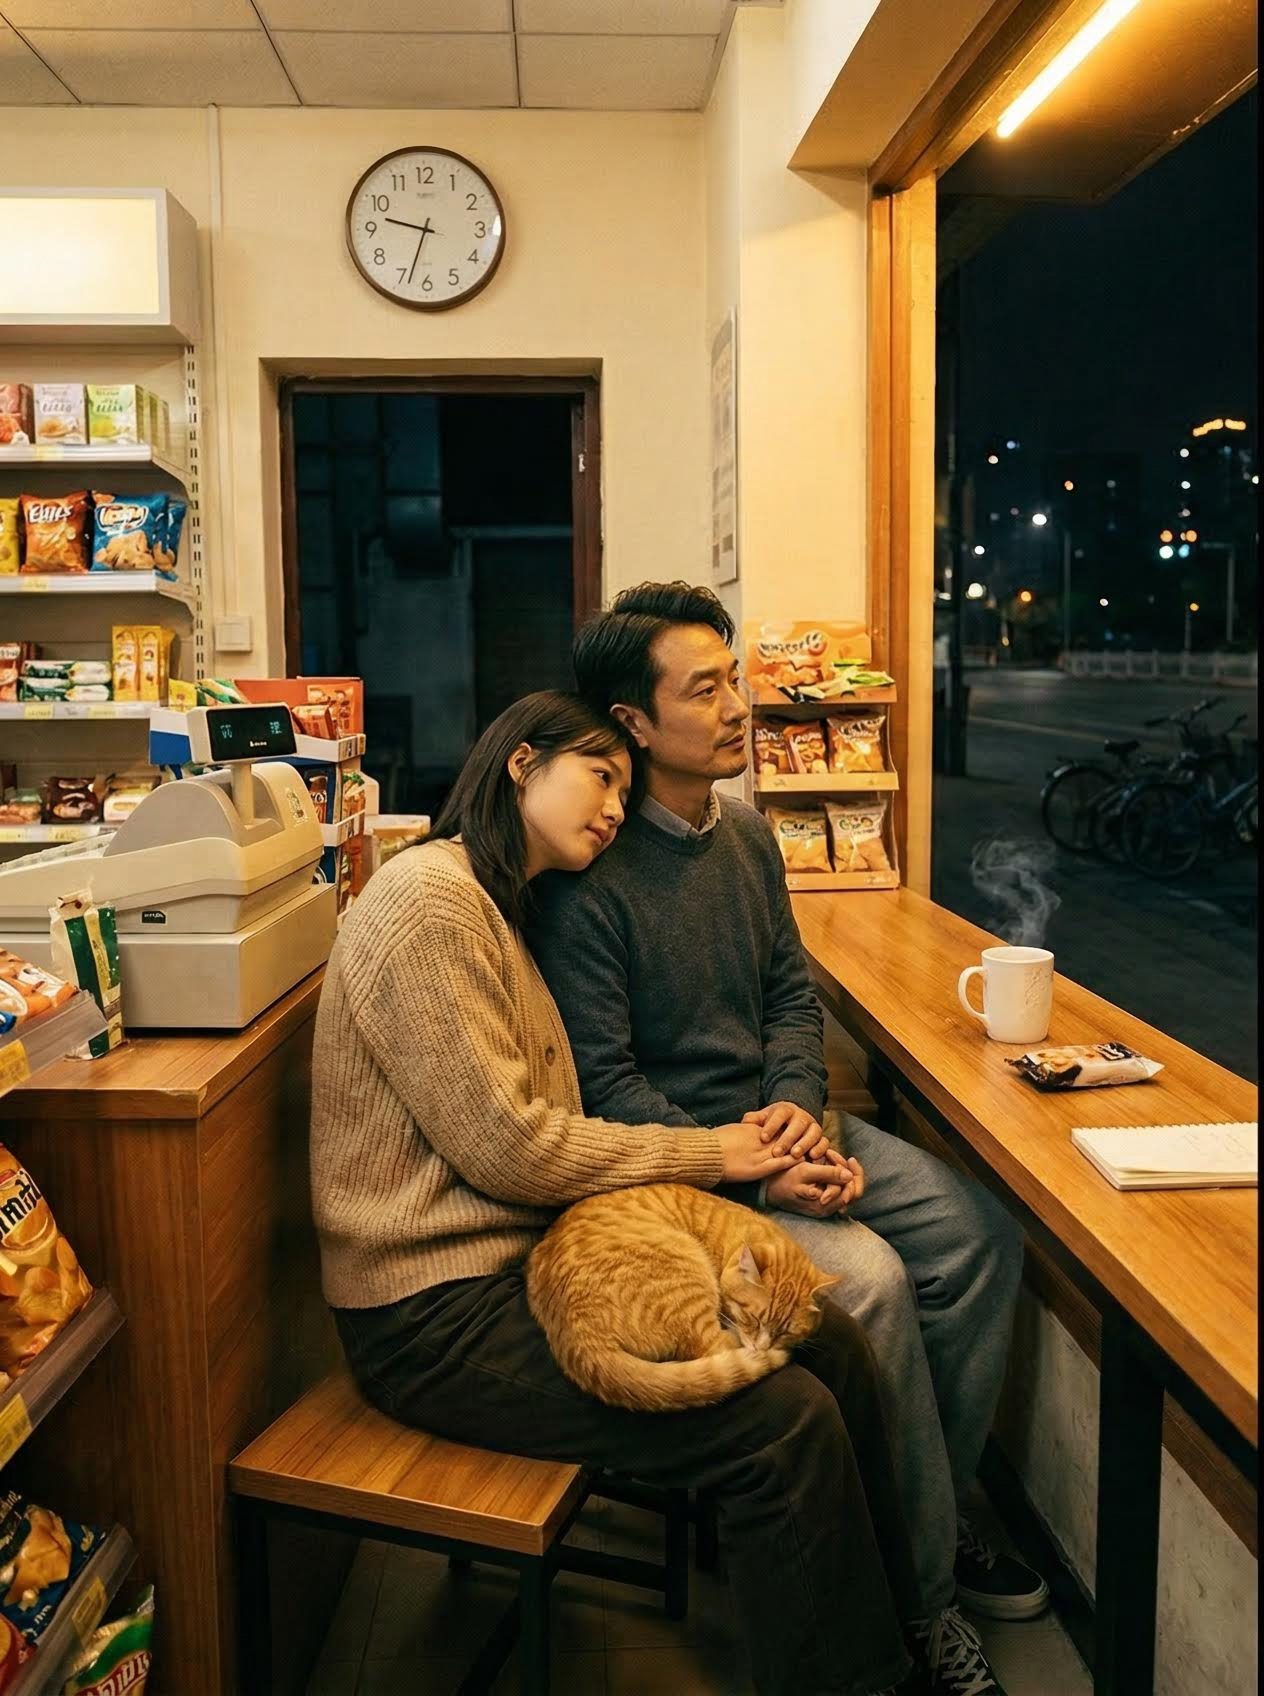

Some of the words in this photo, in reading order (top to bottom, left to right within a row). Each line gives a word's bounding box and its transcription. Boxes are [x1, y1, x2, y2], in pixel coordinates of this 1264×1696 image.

[391, 174, 405, 192] 11
[416, 166, 434, 184] 12
[449, 174, 455, 192] 1
[371, 194, 390, 213] 10
[465, 193, 478, 211] 2
[365, 221, 377, 239] 9
[474, 221, 486, 239] 3
[373, 247, 386, 266] 8
[467, 249, 480, 265] 4
[396, 268, 407, 284] 7
[421, 274, 433, 292] 6
[448, 268, 459, 286] 5
